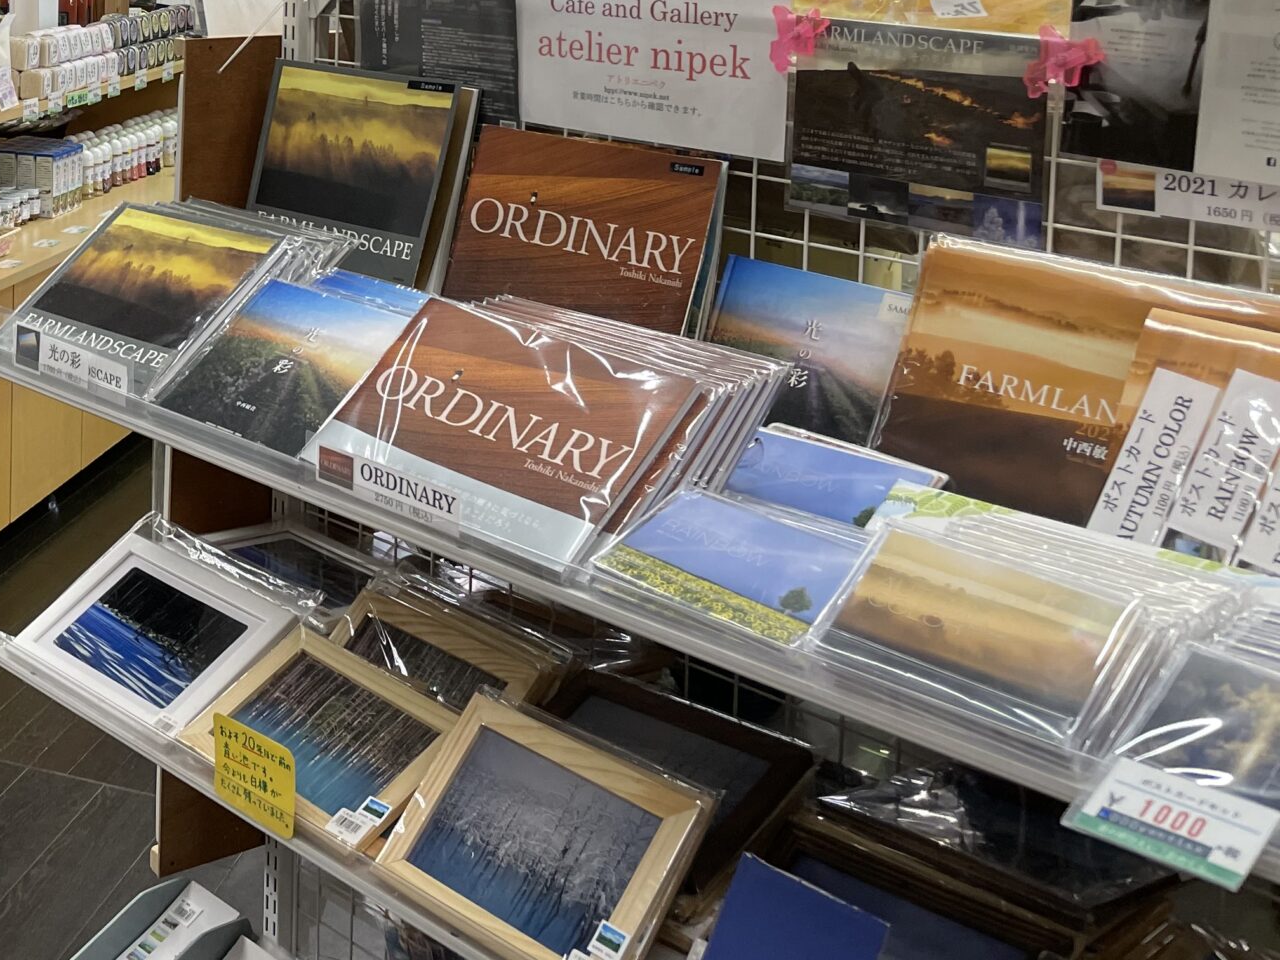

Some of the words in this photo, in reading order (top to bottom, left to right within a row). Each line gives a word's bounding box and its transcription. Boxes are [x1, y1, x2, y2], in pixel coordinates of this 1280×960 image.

[650, 0, 738, 33] Gallery
[537, 29, 639, 67] atelier
[650, 39, 751, 81] nipek
[817, 25, 984, 55] ARMLANDSCAPE
[572, 91, 702, 117] 営業時間はこちらから確認できます。
[674, 163, 700, 175] Sample
[1163, 173, 1219, 198] 2021
[1206, 204, 1237, 220] 1650
[1240, 209, 1254, 223] 円
[470, 197, 696, 275] ORDINARY
[619, 266, 646, 281] Toshiki
[648, 272, 683, 288] Nakanishi
[22, 312, 169, 368] FARMLANDSCAPE
[47, 343, 81, 369] 光の彩
[787, 320, 823, 389] 光の彩
[89, 365, 122, 389] SCAPE
[375, 365, 634, 479] ORDINARY
[1153, 395, 1193, 459] COLOR
[523, 458, 554, 477] Toshiki
[555, 470, 601, 493] Nakanishi
[1103, 409, 1156, 513] ポストカード
[1180, 411, 1237, 517] ポストカード
[1207, 428, 1260, 522] RAINBOW
[360, 462, 457, 515] ORDINARY
[374, 492, 394, 507] 2750
[1152, 493, 1170, 518] 1100
[1139, 799, 1208, 839] 1000
